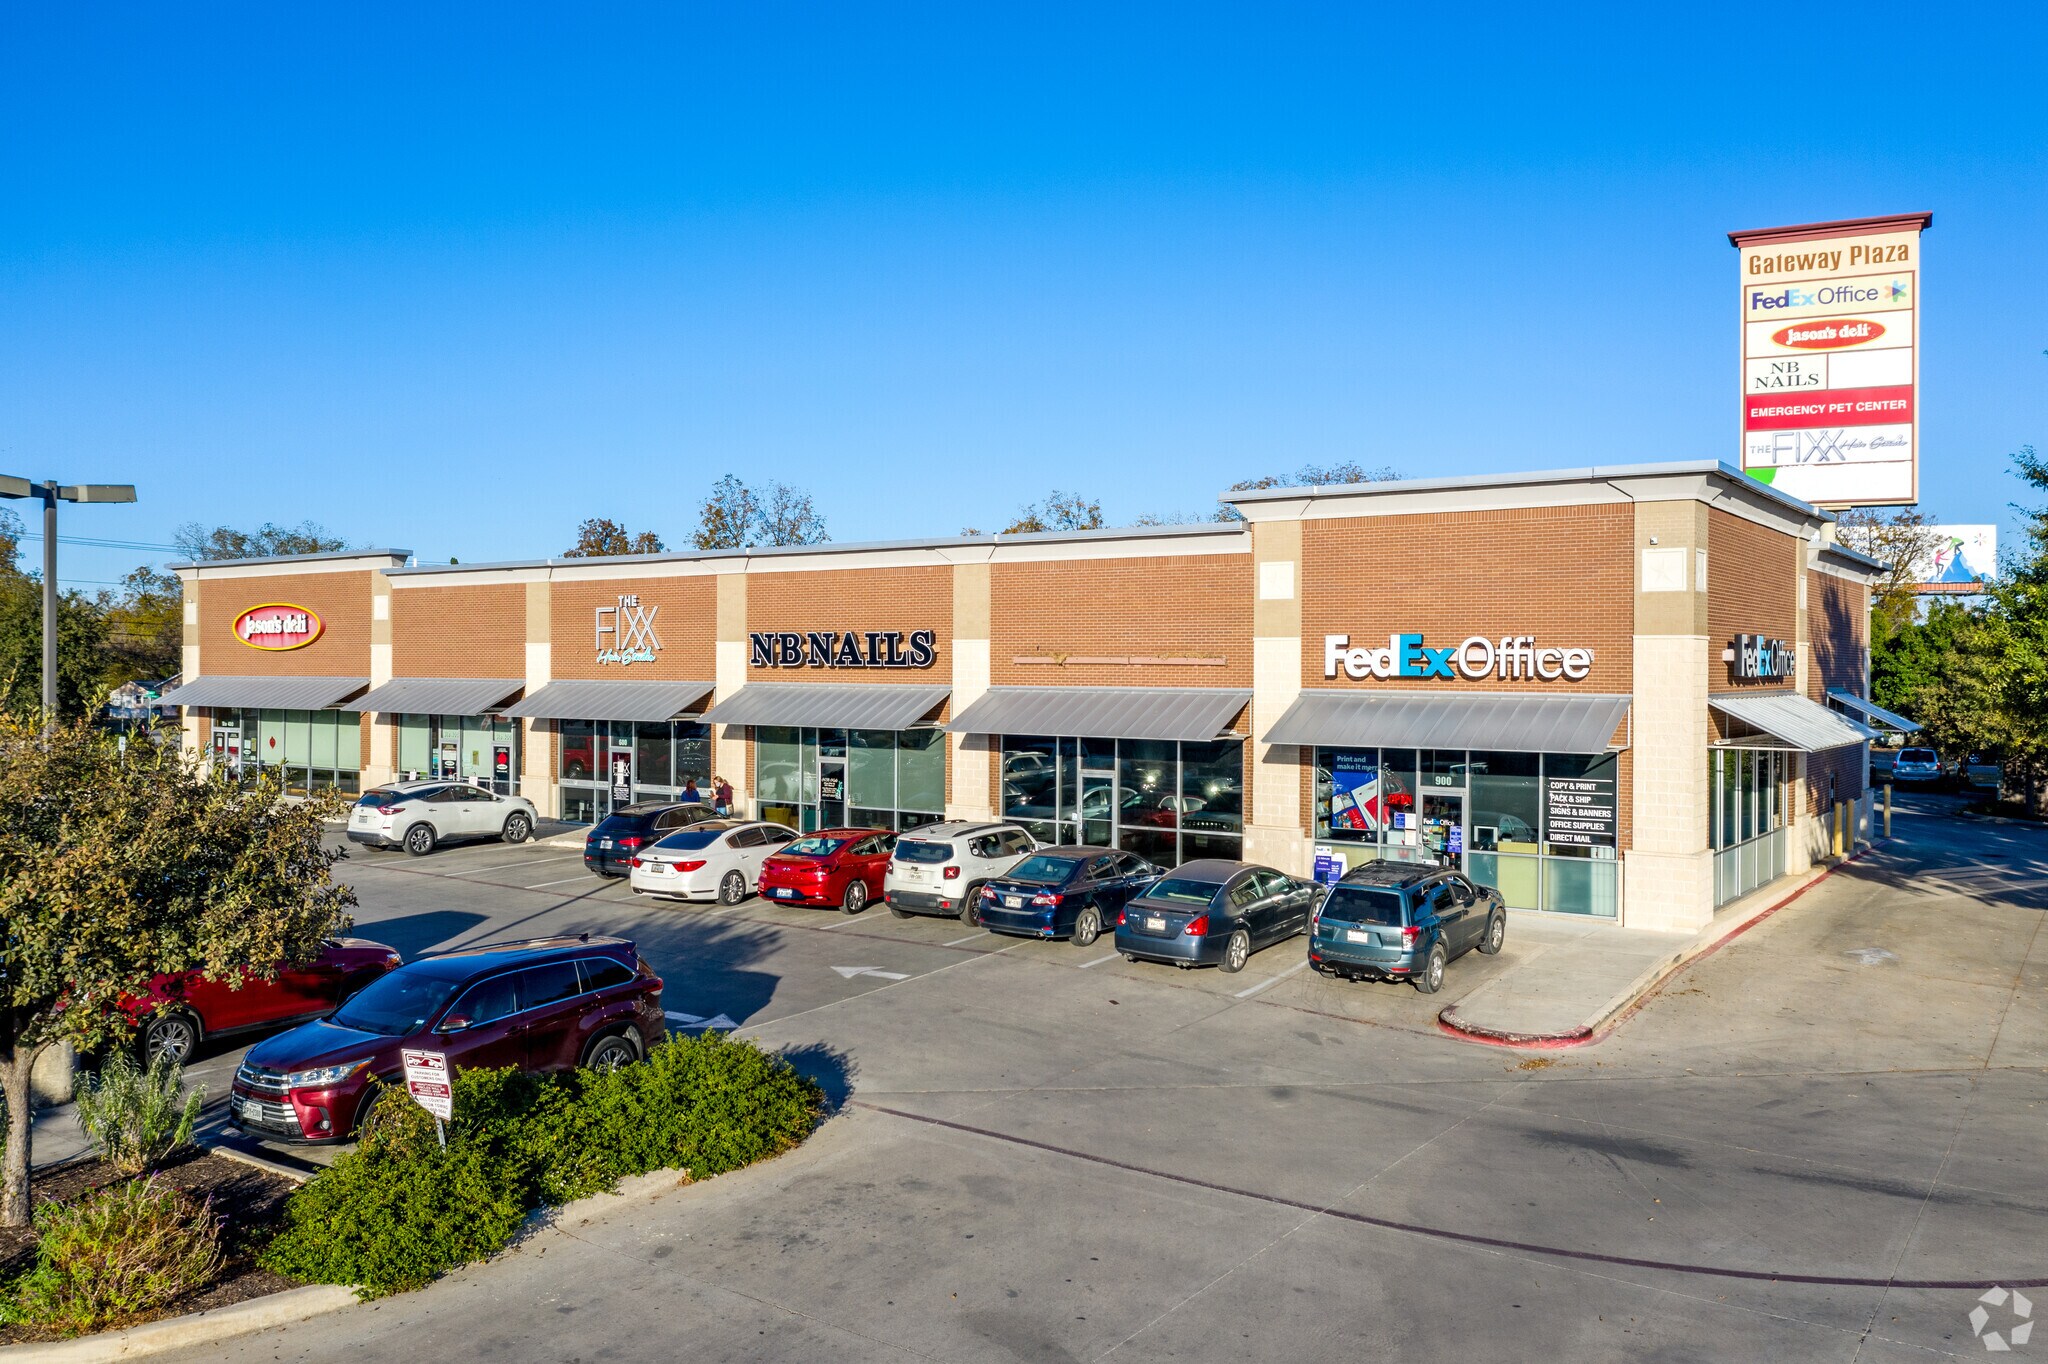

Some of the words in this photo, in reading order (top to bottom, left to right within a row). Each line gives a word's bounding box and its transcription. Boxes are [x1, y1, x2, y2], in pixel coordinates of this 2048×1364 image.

[1749, 251, 1842, 275] Gateway
[1850, 244, 1909, 266] Plaza
[1752, 289, 1815, 310] FedEx
[1817, 285, 1879, 305] Office
[1839, 323, 1869, 339] deli
[1770, 361, 1800, 375] NB
[1755, 373, 1819, 389] NAILS
[1750, 404, 1826, 418] EMERGENCY
[1829, 402, 1853, 414] PET
[1855, 400, 1907, 412] CENTER
[1750, 445, 1771, 454] THE
[1772, 429, 1846, 464] FIXX
[618, 594, 638, 607] THE
[283, 614, 308, 634] deli
[595, 606, 661, 650] FIXX
[749, 632, 803, 667] NB
[806, 630, 935, 668] NAILS
[1324, 633, 1456, 678] FedEx
[1457, 635, 1592, 679] Office
[1740, 634, 1771, 677] FedEx
[1771, 639, 1795, 677] Office
[1435, 776, 1452, 786] 900
[1550, 781, 1568, 789] COPY
[1569, 782, 1575, 790] &
[1388, 794, 1412, 805] OPEN
[1550, 794, 1568, 802] PACK
[1569, 795, 1575, 803] &
[1550, 807, 1571, 815] SIGNS
[1572, 808, 1577, 816] &
[1578, 809, 1611, 817] BANNERS
[1550, 820, 1572, 828] OFFICE
[1573, 822, 1605, 830] SUPPLIES
[1574, 835, 1591, 843] MAIL
